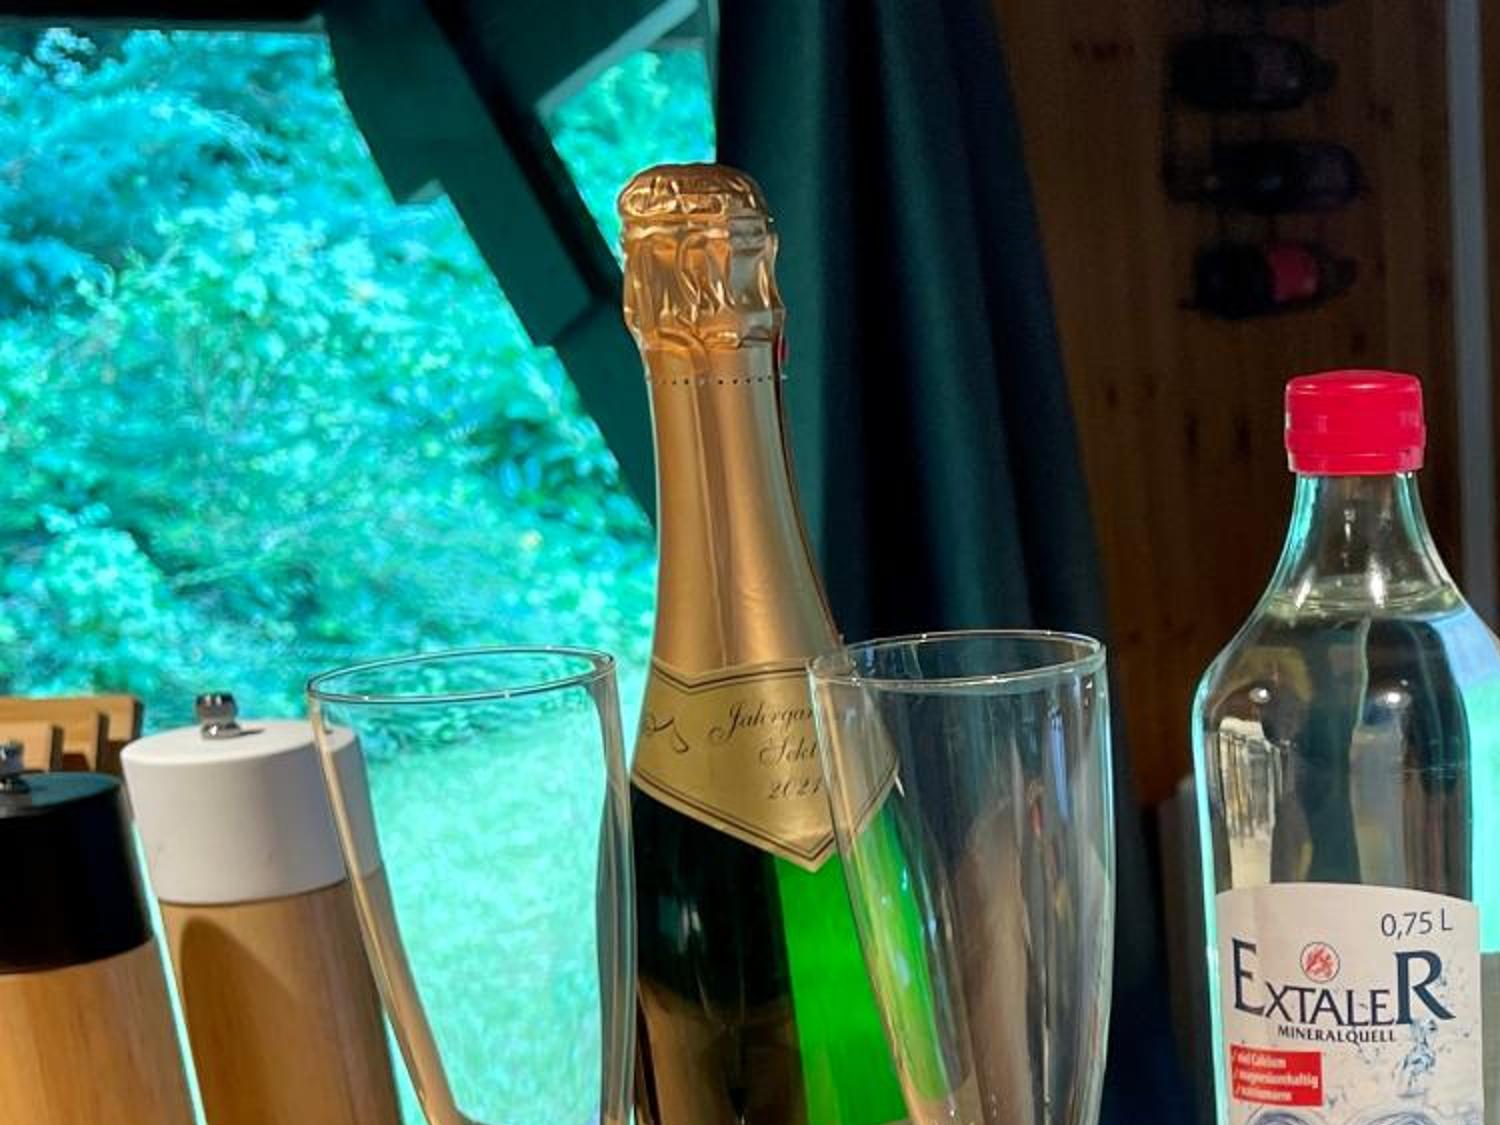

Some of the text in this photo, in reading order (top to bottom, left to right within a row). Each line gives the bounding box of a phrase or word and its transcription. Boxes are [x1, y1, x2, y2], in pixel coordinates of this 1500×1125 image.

[1380, 907, 1454, 940] 0,75 L
[1277, 1024, 1398, 1046] MINERALQUELL
